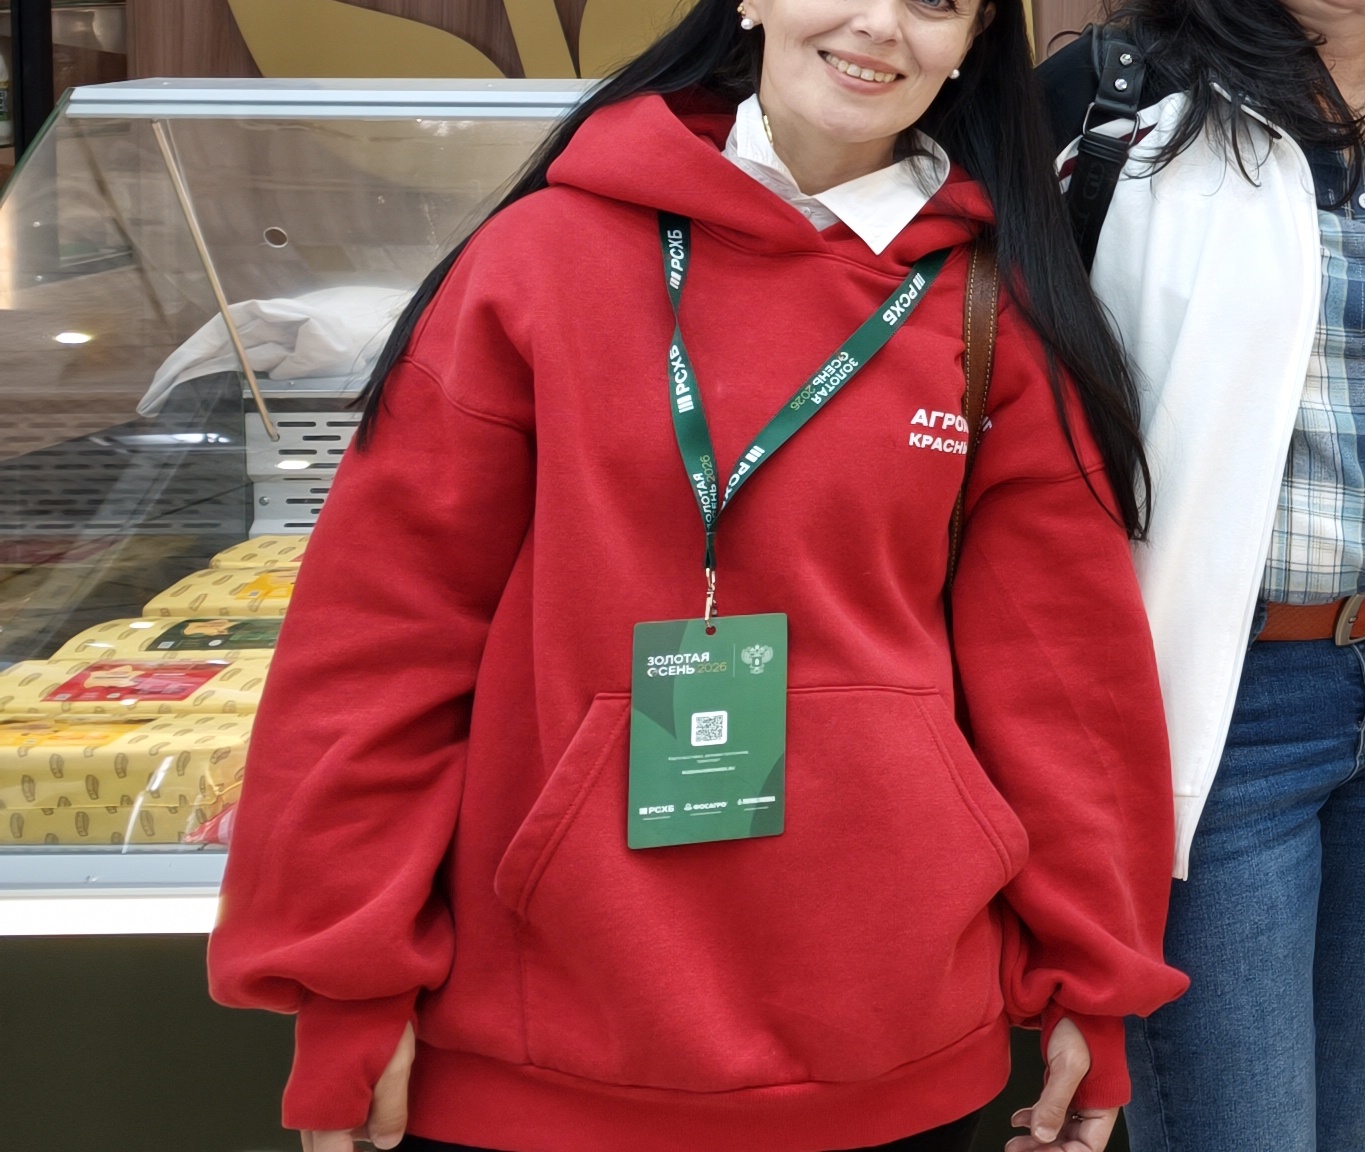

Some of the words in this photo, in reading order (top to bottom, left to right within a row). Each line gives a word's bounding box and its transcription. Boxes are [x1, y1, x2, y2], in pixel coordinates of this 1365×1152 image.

[667, 229, 684, 278] РСХБ
[883, 286, 918, 326] РСХБ
[669, 344, 690, 396] РСХБ
[811, 357, 858, 405] ЗОЛОТАЯ
[790, 385, 816, 410] 2026
[700, 454, 716, 482] 2026
[647, 652, 710, 666] ЗОЛОТАЯ
[697, 662, 727, 673] 2026
[648, 805, 675, 814] РСХБ
